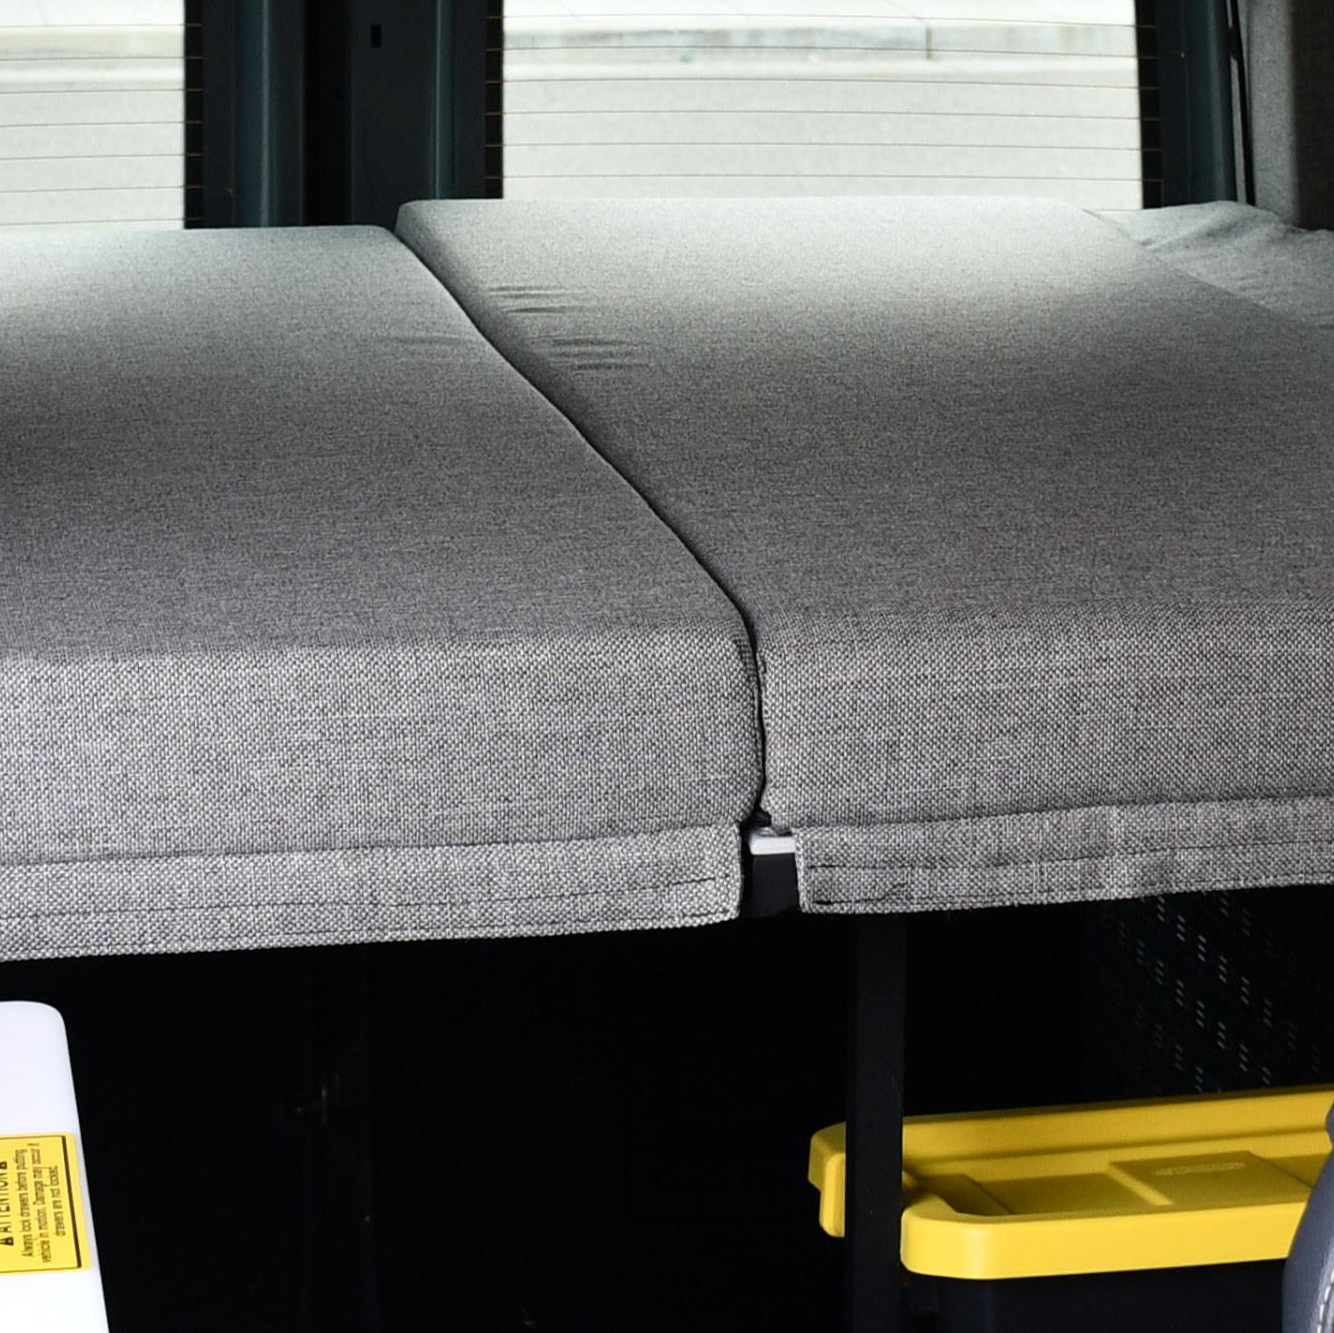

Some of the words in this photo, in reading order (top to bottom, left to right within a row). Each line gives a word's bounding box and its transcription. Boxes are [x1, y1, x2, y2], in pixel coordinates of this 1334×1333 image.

[15, 1149, 27, 1170] putting
[31, 1148, 40, 1164] occur
[17, 1172, 27, 1191] before
[33, 1167, 43, 1179] may
[33, 1180, 46, 1205] Damage
[50, 1188, 60, 1198] not
[19, 1193, 30, 1217] drawers
[53, 1200, 62, 1209] are
[21, 1220, 31, 1232] lock
[54, 1211, 65, 1236] drawers
[23, 1234, 34, 1257] Always
[39, 1240, 51, 1263] vehicle
